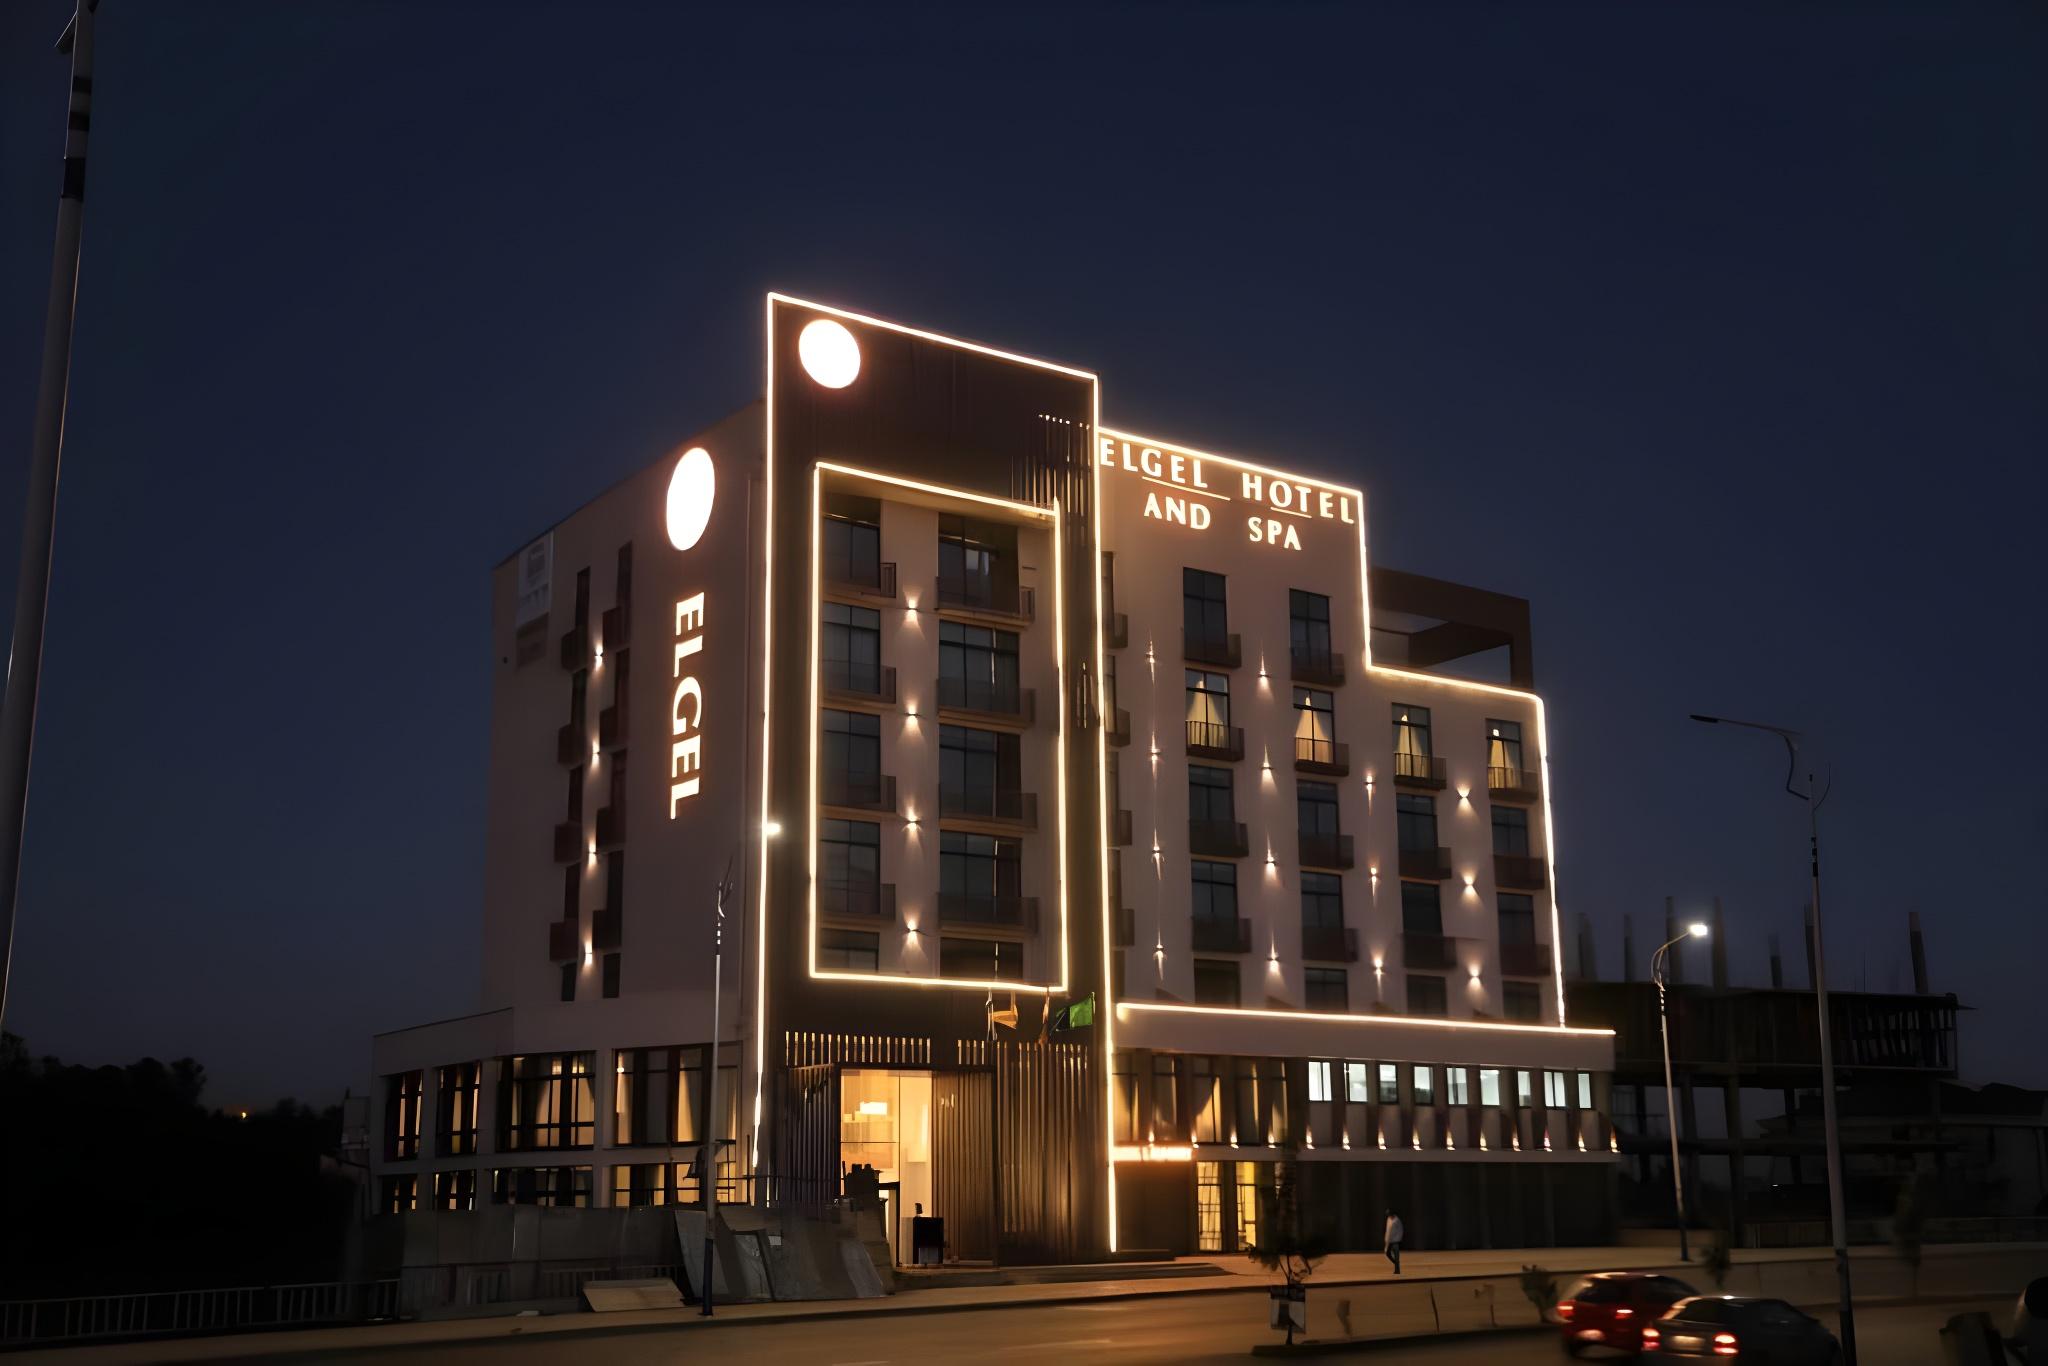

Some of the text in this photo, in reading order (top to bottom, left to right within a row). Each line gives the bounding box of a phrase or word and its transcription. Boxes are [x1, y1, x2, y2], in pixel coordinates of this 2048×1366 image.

[1100, 438, 1354, 524] ELGEL HOTEL
[1143, 493, 1302, 551] AND SPA
[670, 592, 705, 820] ELGEL
